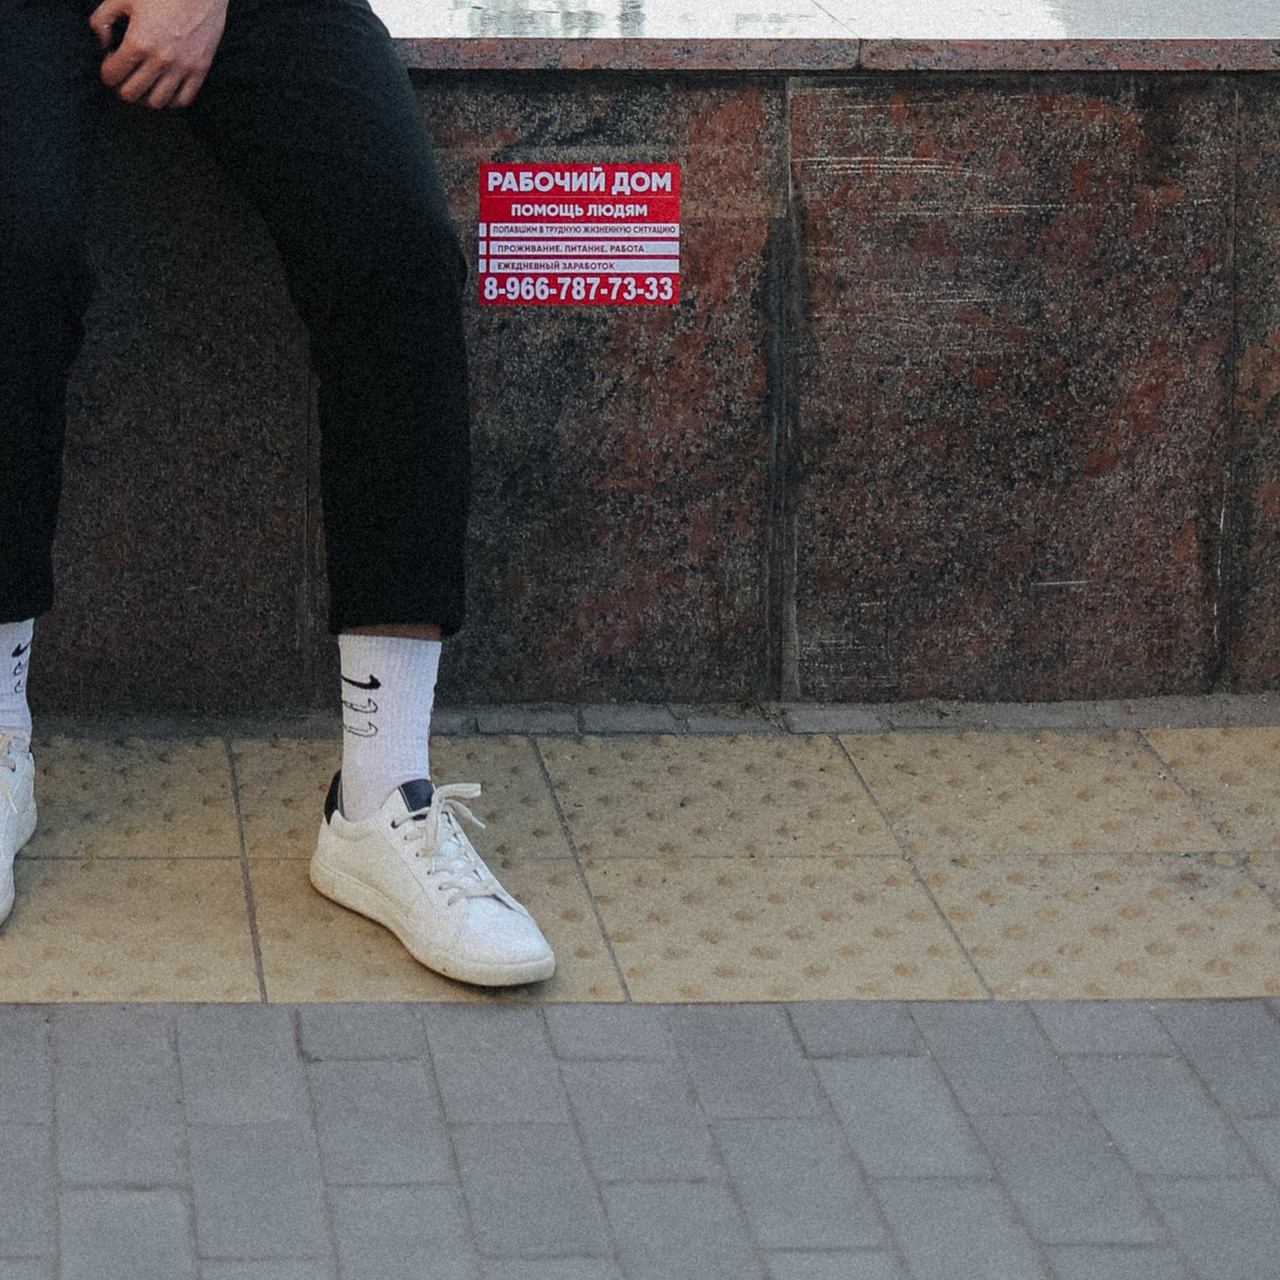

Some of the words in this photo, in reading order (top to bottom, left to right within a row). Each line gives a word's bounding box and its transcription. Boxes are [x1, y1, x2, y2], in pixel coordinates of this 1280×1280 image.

[487, 167, 606, 192] РАБОЧИЙ
[611, 171, 672, 195] ДОМ
[511, 203, 584, 218] ПОМОЩЬ
[586, 203, 648, 218] ЛЮДЯМ
[493, 226, 537, 234] ПОПАВШИМ
[539, 226, 544, 234] В
[544, 226, 582, 234] ТРУДНУЮ
[583, 226, 632, 234] ЖИЗНЕННУЮ
[633, 226, 676, 234] СИТУАЦИЮ
[497, 245, 563, 253] ПРОЖИВАНИЕ.
[565, 245, 608, 253] ПИТАНИЕ.
[610, 245, 645, 253] РАБОТА
[497, 260, 560, 271] ЕЖЕДНЕВНЫЙ
[562, 262, 615, 270] ЗАРАБОТОК
[484, 276, 673, 300] 8-966-787-73-33
